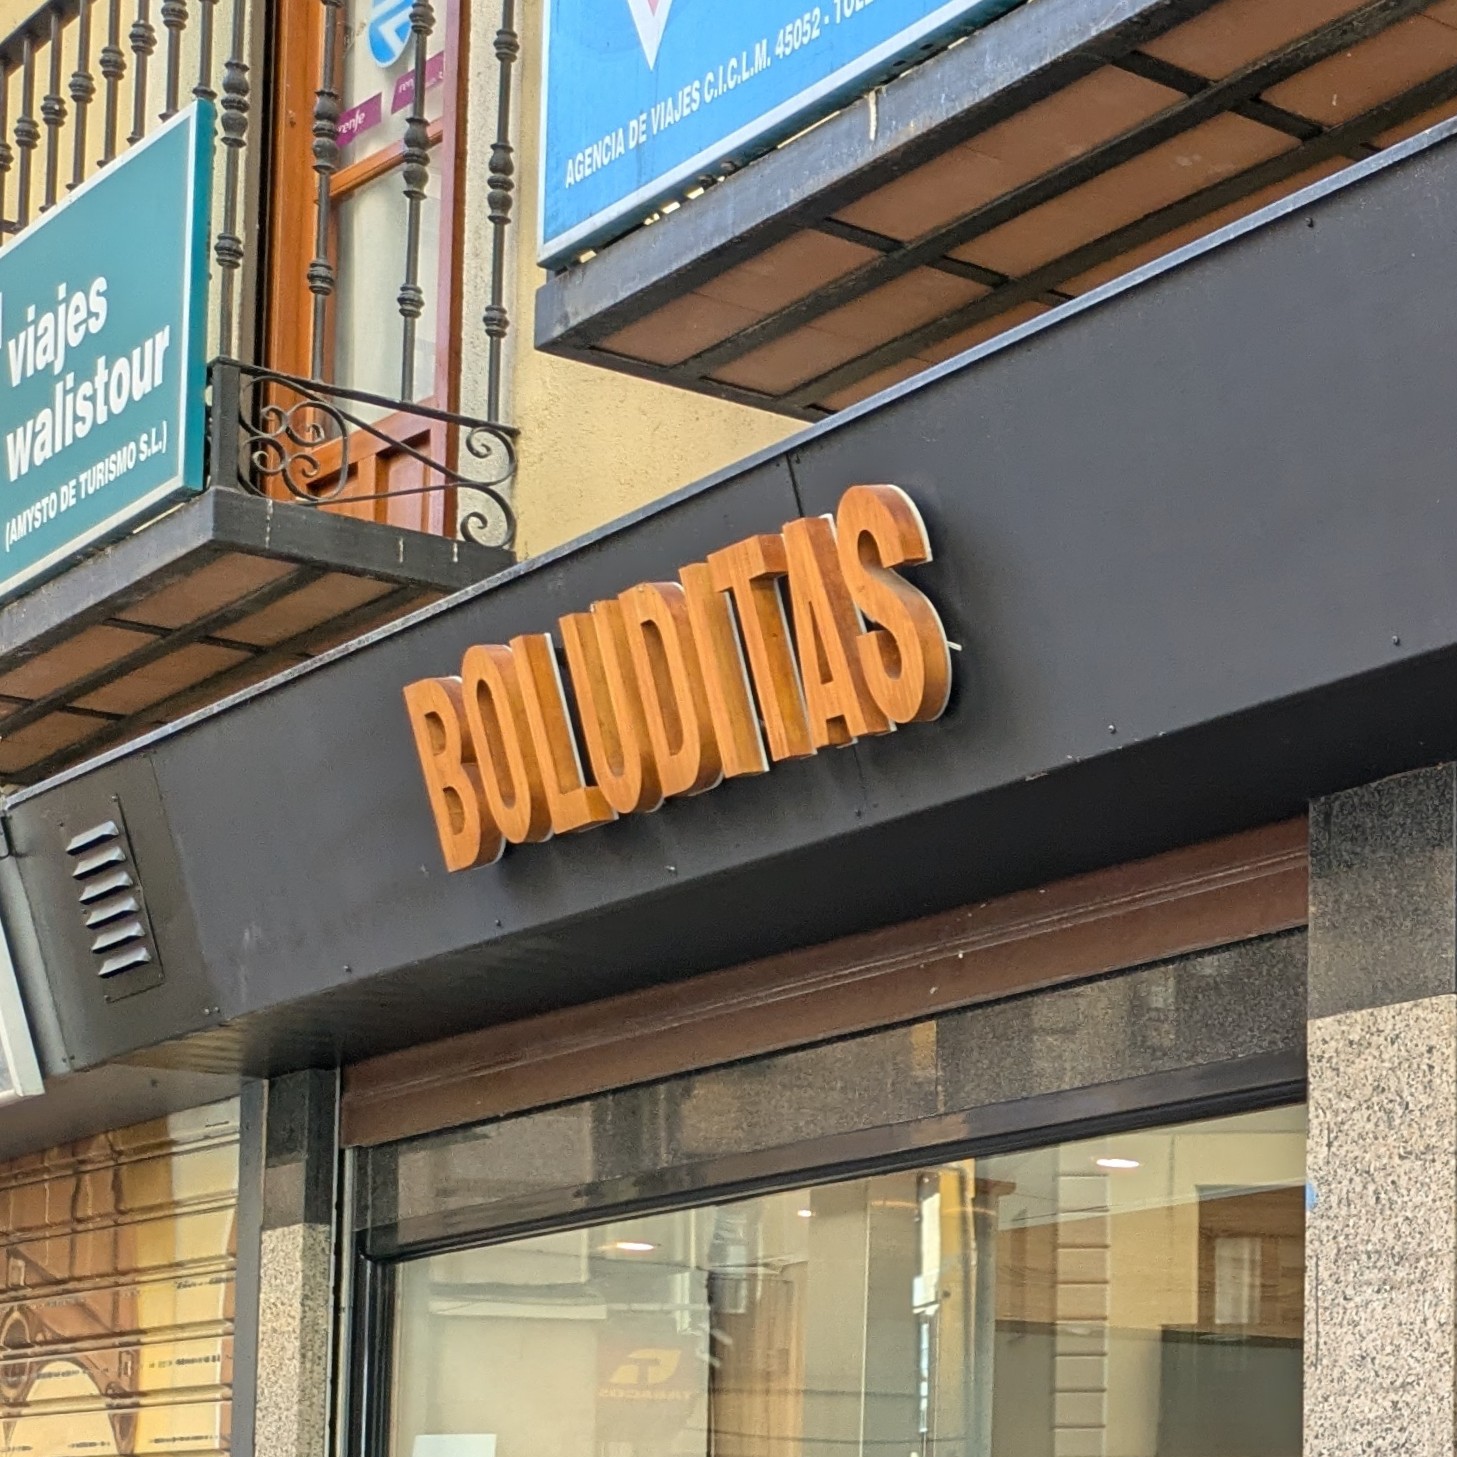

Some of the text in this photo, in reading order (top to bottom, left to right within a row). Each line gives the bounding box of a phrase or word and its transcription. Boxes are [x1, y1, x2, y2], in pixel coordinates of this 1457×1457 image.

[565, 140, 625, 188] AGENCIA
[628, 121, 647, 150] DE
[651, 91, 701, 134] VIAJES
[703, 41, 771, 104] C.I.C.L.M.
[775, 8, 821, 58] 45052
[6, 325, 170, 482] walistour
[8, 276, 108, 387] viajes
[5, 421, 167, 552] (AMYSTO DE TURISMO S.L.)
[403, 484, 952, 872] BOLUDITAS
